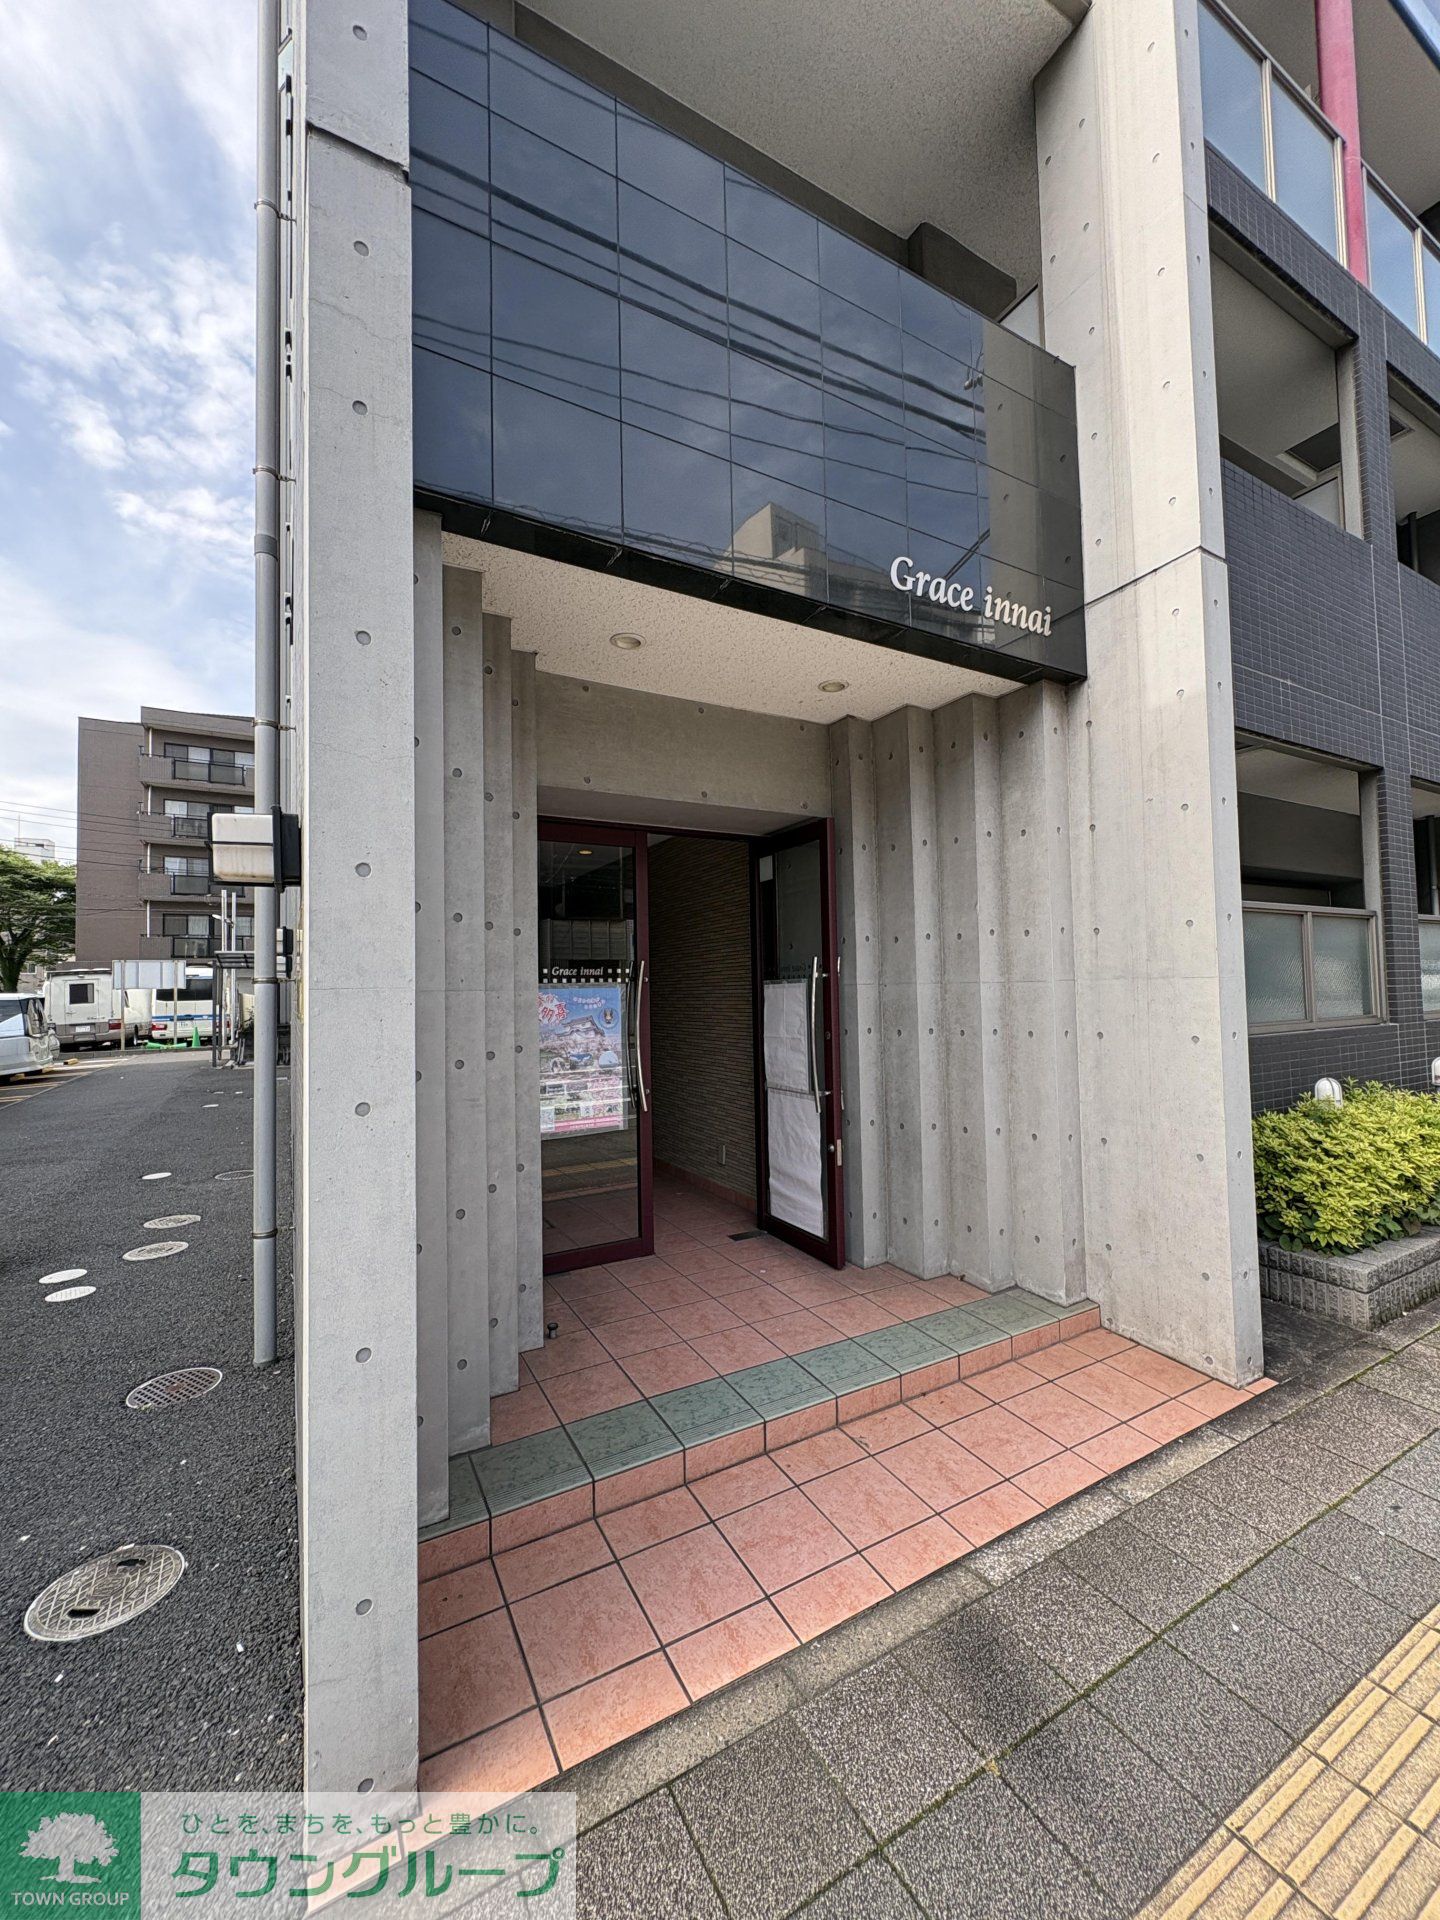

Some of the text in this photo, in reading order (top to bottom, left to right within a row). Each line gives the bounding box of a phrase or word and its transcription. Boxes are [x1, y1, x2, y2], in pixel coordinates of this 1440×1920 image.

[890, 556, 1052, 637] Grace innai
[551, 966, 604, 976] Grace innai
